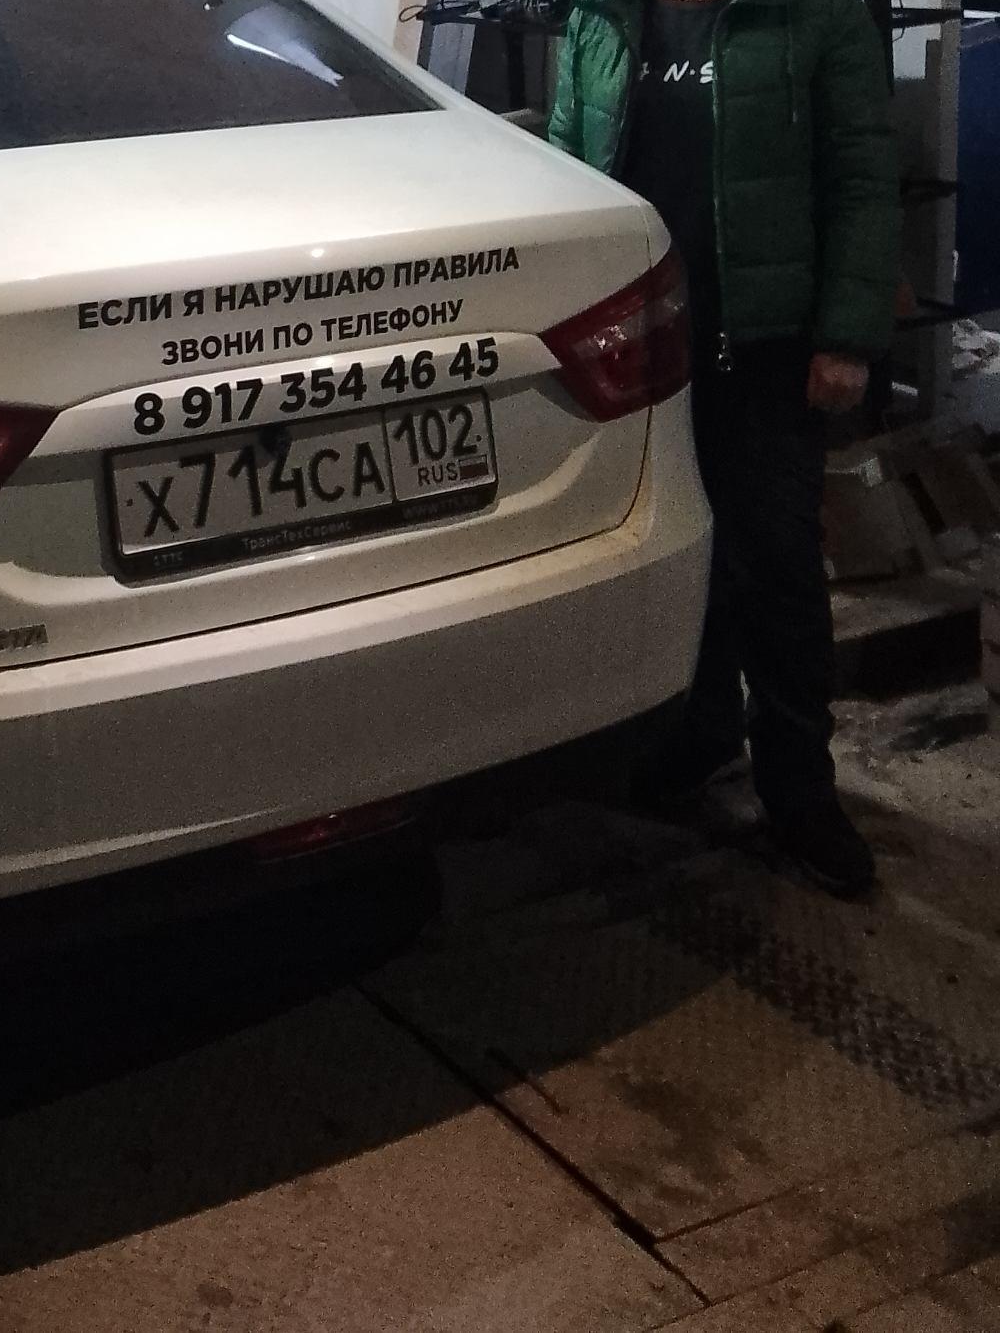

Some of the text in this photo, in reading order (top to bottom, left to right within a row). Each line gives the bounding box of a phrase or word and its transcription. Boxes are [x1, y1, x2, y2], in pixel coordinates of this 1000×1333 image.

[78, 247, 520, 329] ЕСЛИ Я НАРУШАЮ ПРАВИЛА
[161, 299, 463, 365] ЗВОНИ ПО ТЕЛЕФОНУ
[133, 338, 499, 435] 8 917 354 46 45
[394, 403, 478, 466] 102
[417, 462, 458, 487] RUS
